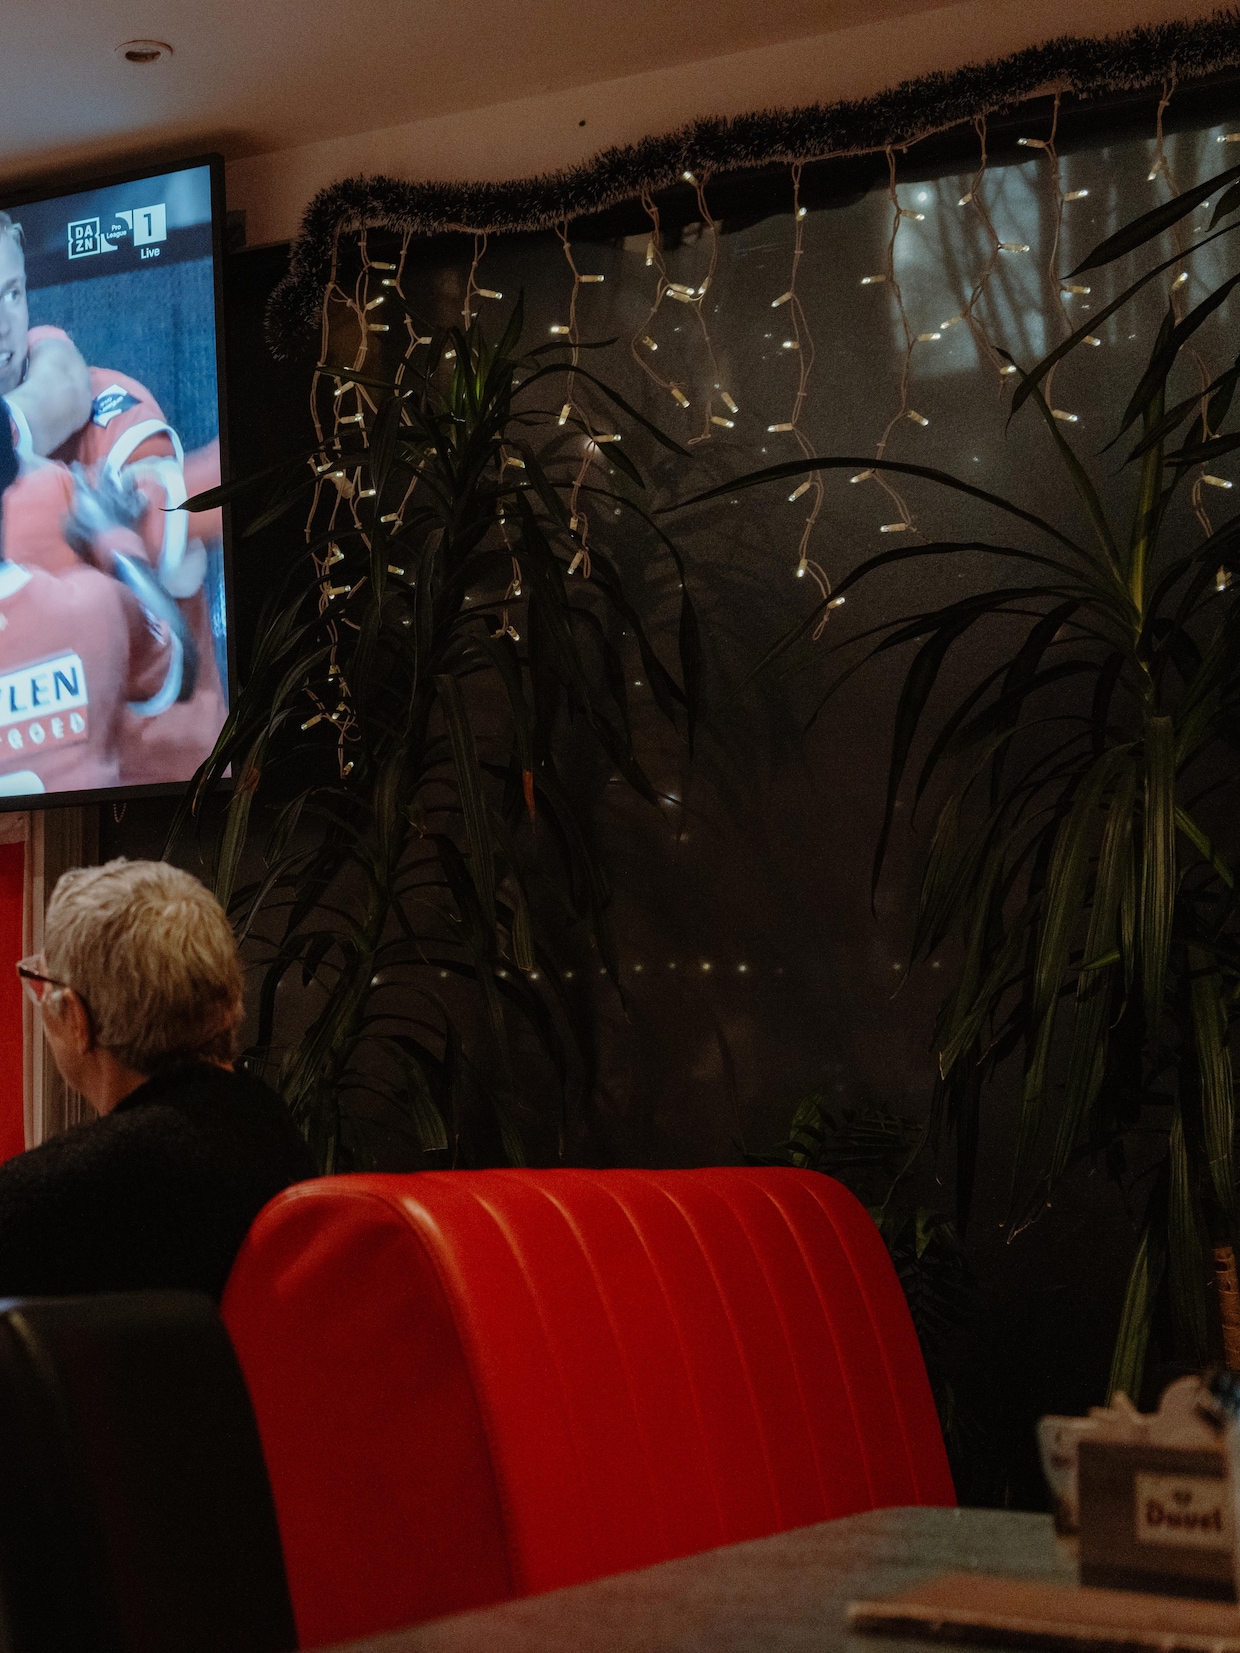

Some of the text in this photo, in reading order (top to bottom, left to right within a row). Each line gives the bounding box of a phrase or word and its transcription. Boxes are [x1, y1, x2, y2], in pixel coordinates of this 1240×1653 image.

[143, 212, 152, 237] 1
[106, 230, 127, 239] League
[141, 248, 160, 259] Live
